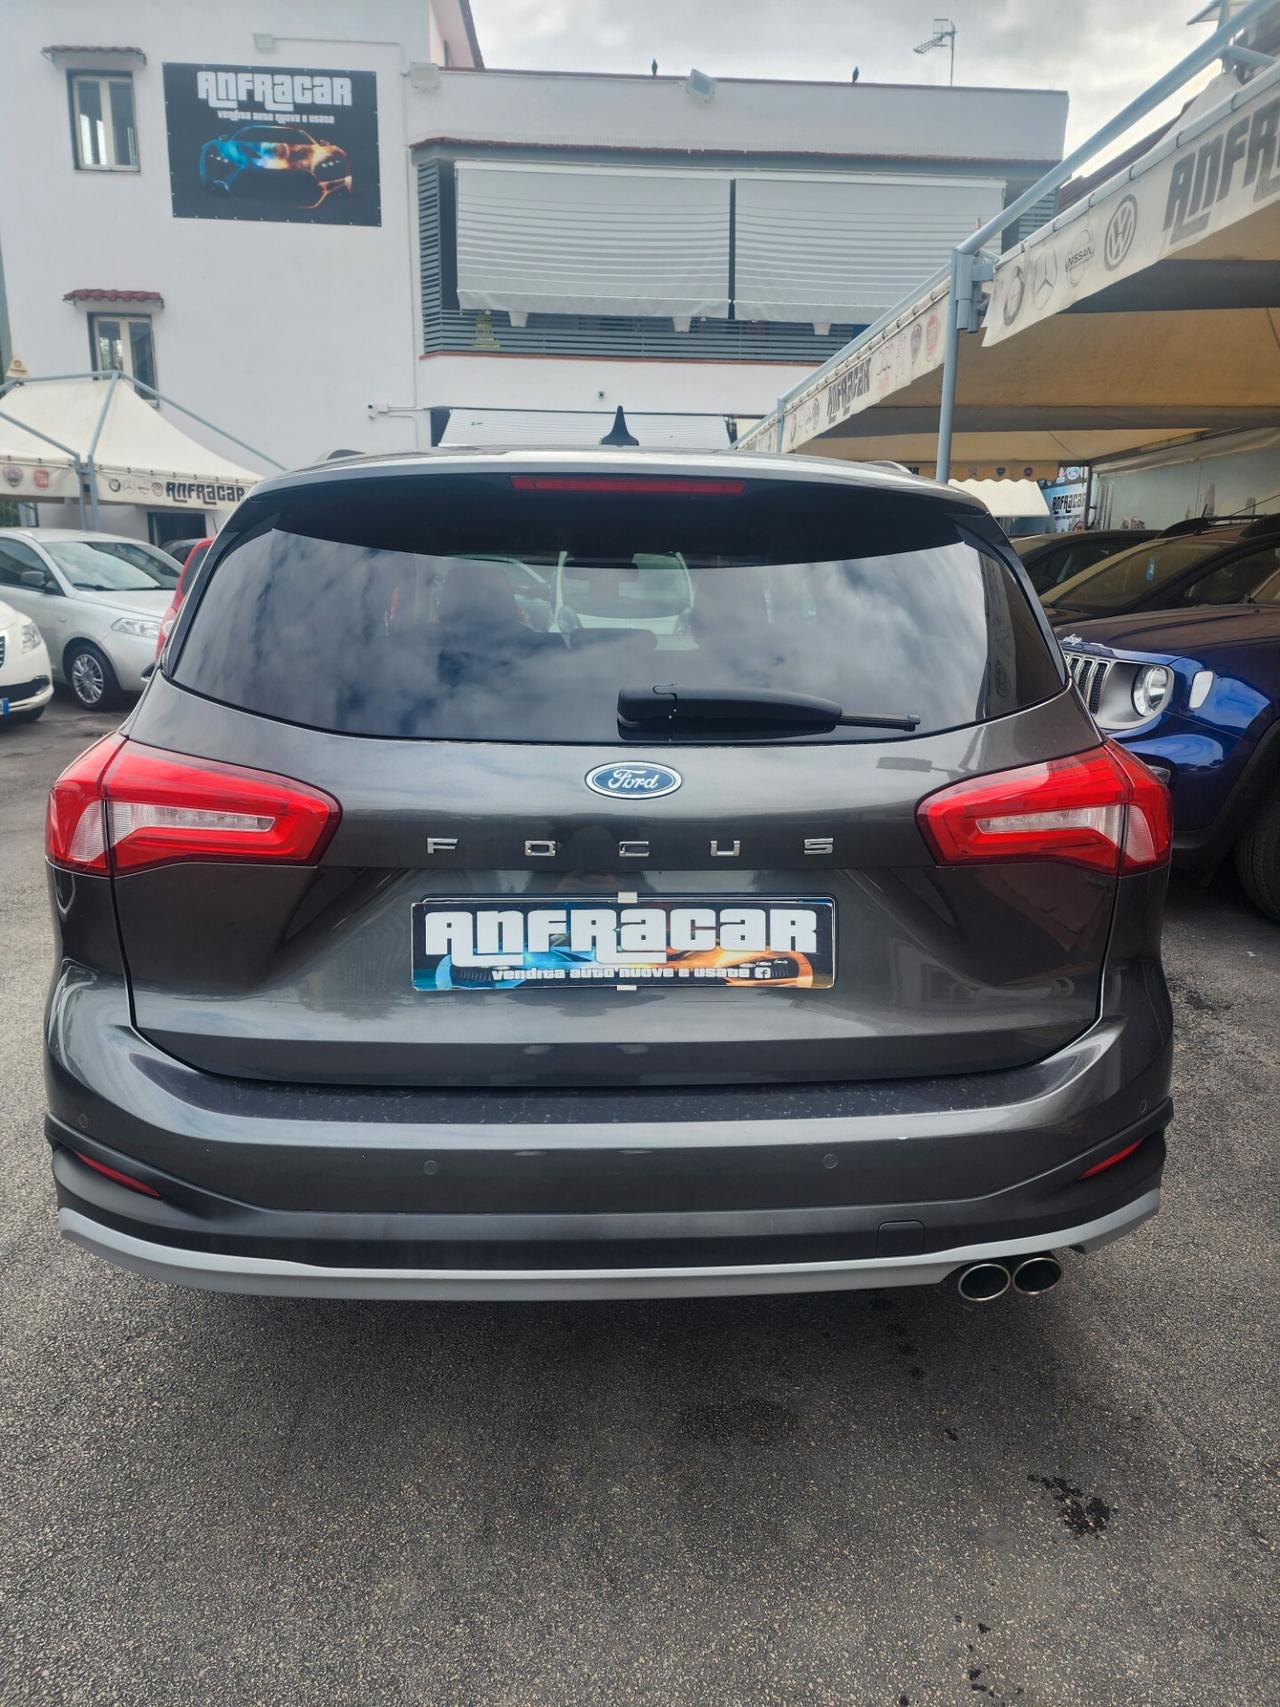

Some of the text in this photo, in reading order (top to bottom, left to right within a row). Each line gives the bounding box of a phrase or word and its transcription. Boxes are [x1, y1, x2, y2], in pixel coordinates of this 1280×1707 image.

[1065, 246, 1095, 272] NISSAN
[608, 769, 660, 789] Ford
[426, 837, 834, 858] FOCUS
[569, 968, 615, 979] auto
[619, 967, 674, 978] nuove
